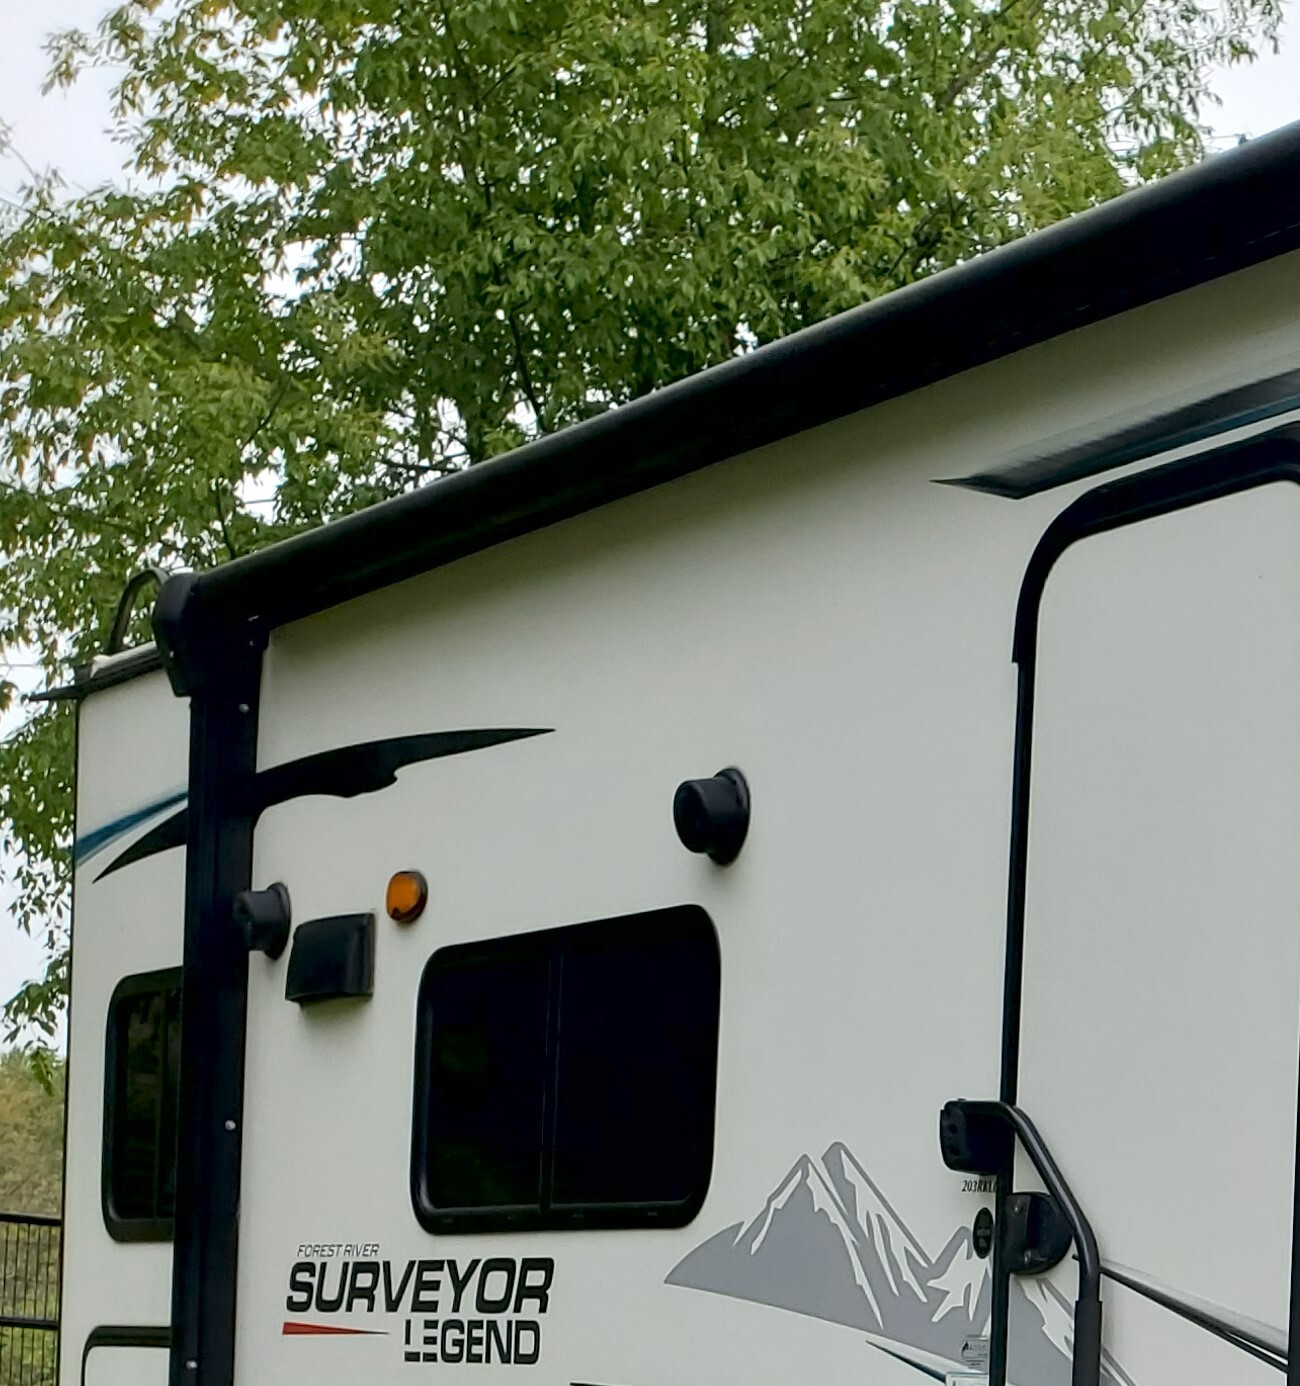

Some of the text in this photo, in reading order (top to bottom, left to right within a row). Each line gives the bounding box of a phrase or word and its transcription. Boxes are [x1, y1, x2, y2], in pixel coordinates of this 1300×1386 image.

[297, 1243, 380, 1258] FOREST RIVER
[286, 1257, 555, 1313] SURVEYOR
[404, 1319, 540, 1365] LEGEND
